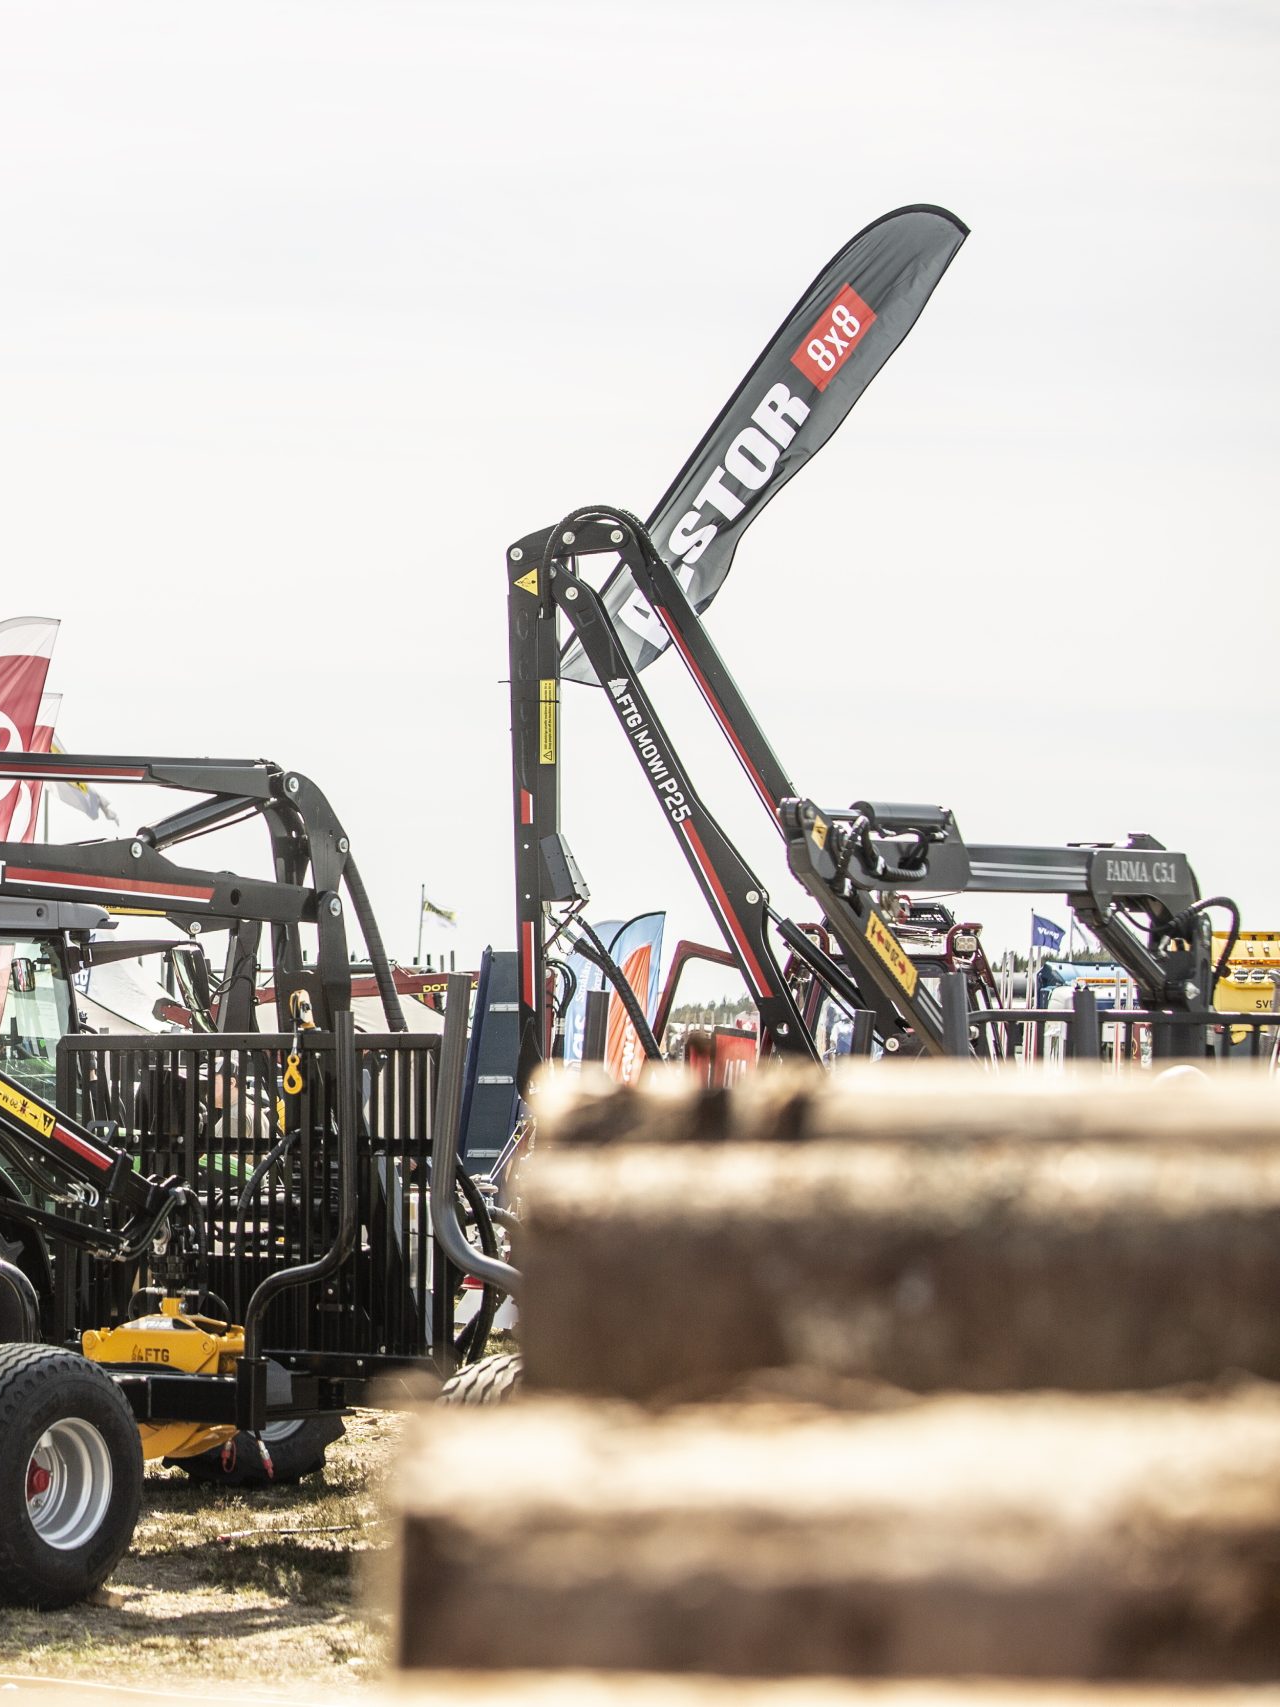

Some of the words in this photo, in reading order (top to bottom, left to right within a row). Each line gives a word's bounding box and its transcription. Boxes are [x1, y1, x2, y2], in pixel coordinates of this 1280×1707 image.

[618, 382, 811, 651] ASTOR
[805, 303, 861, 372] 8x8
[616, 693, 643, 728] FTG
[634, 729, 669, 781] MOWI
[657, 777, 692, 823] P25
[1106, 859, 1149, 882] FARMA
[1152, 862, 1176, 883] C5.1
[423, 983, 448, 993] DOT
[144, 1347, 170, 1363] FTG
